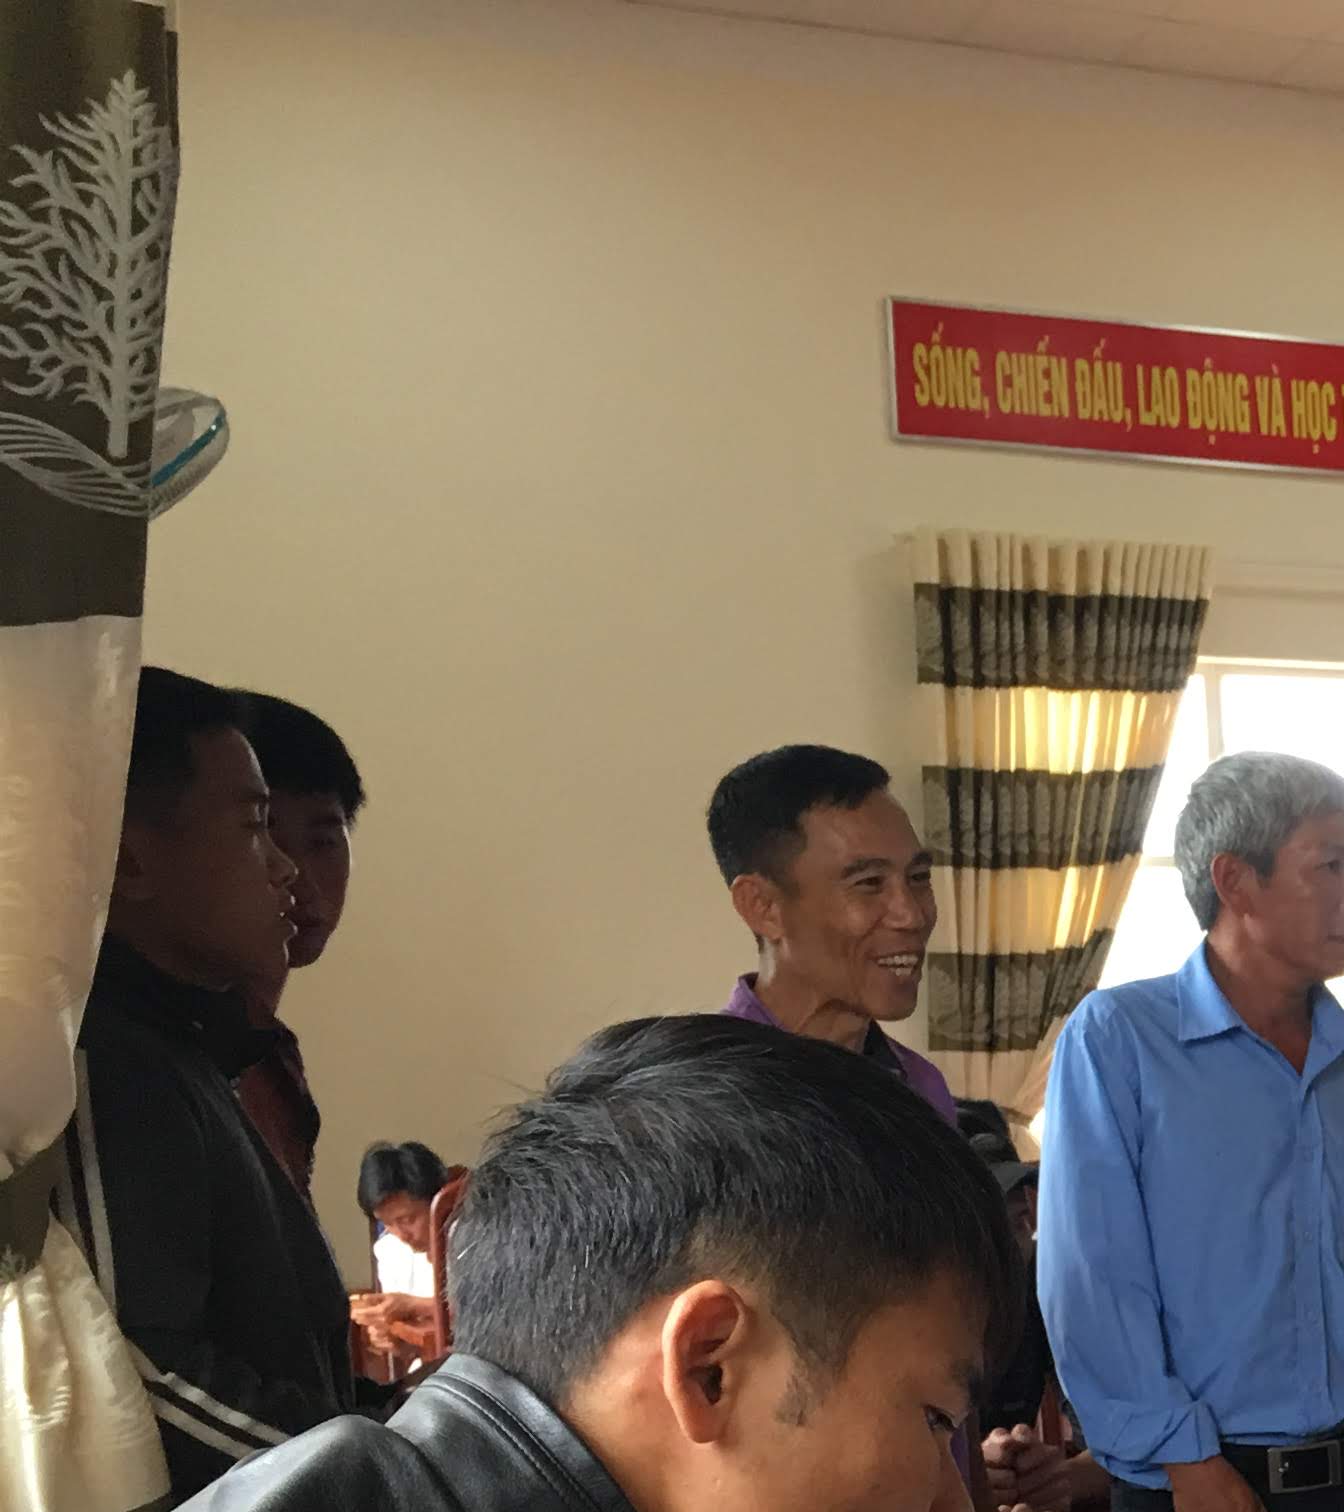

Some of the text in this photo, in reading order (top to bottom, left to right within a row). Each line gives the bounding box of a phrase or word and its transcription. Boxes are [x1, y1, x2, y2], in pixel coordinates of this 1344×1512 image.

[913, 322, 990, 418] SỐNG,
[995, 335, 1070, 418] CHIẾN
[1075, 338, 1132, 431] ĐẤU,
[1136, 364, 1181, 428] LAO
[1186, 357, 1250, 445] ĐỘNG
[1255, 363, 1287, 437] VÀ
[1290, 379, 1337, 454] HỌC
